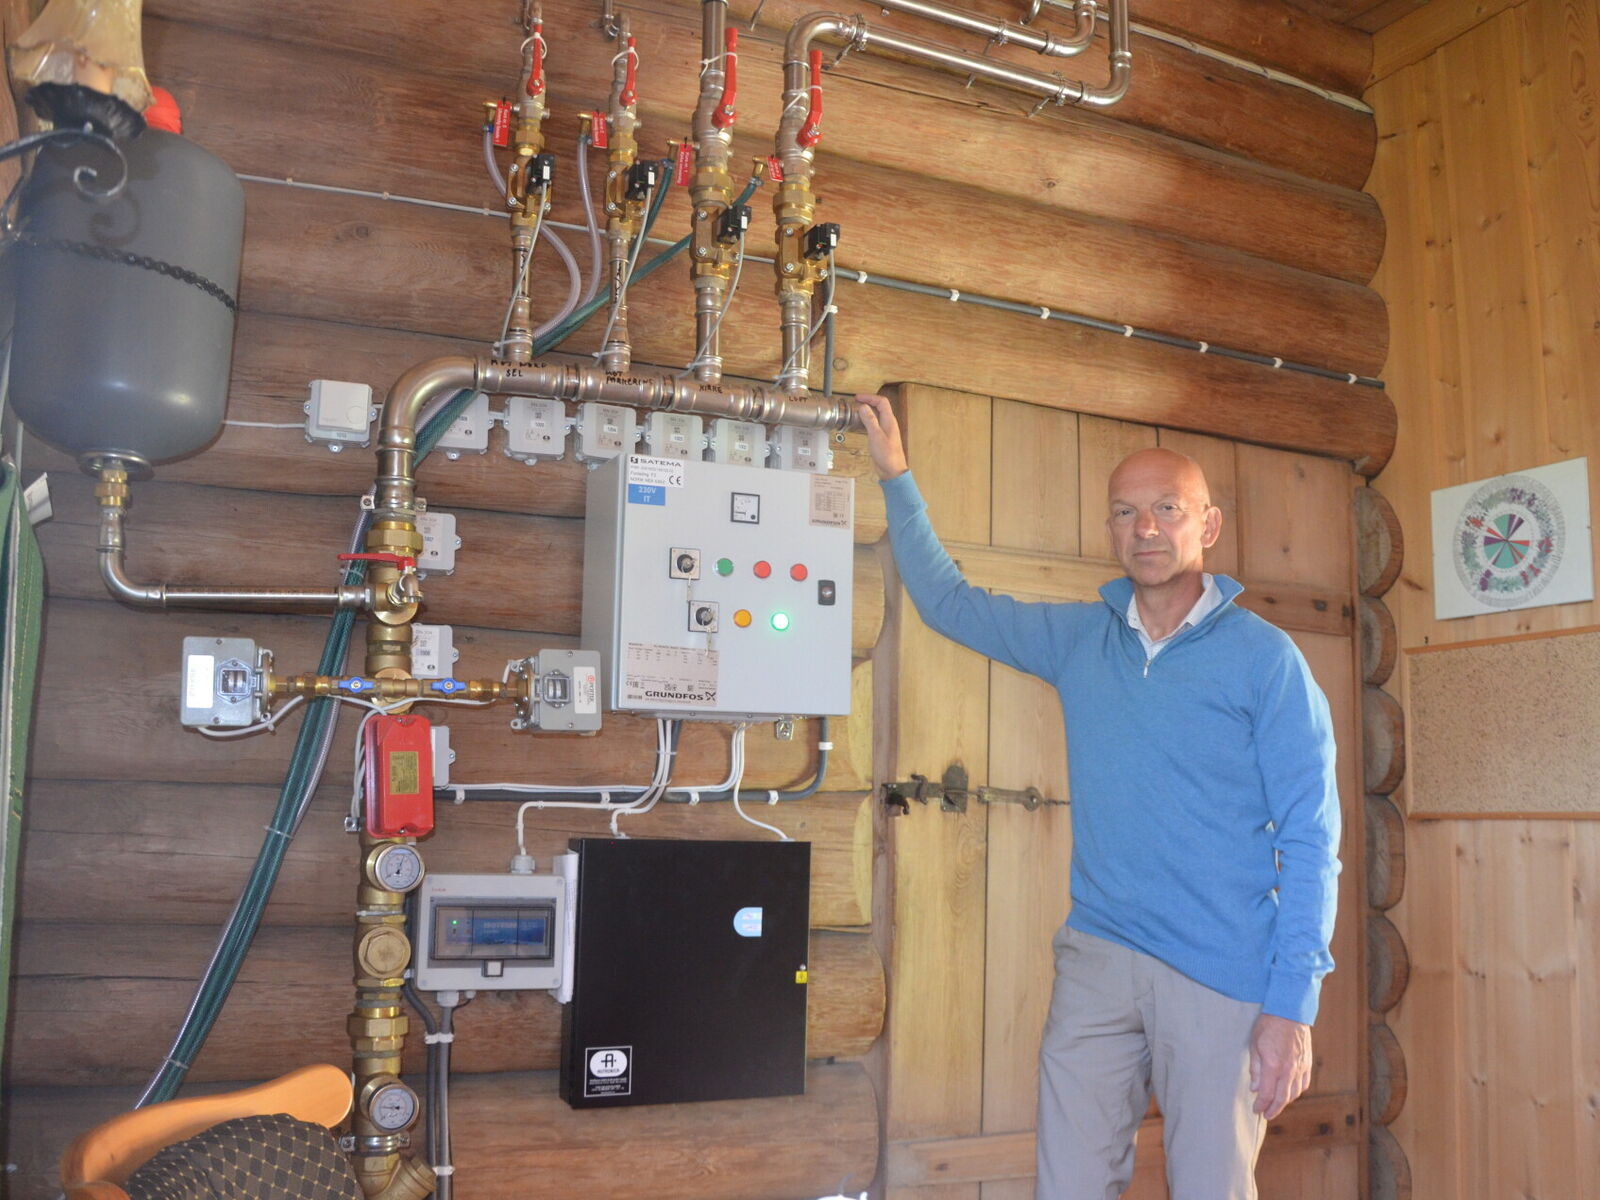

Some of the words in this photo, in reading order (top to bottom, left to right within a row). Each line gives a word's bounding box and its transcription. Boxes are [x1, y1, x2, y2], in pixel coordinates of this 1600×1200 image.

[640, 458, 682, 467] SATEMA
[638, 485, 657, 494] 230V
[643, 495, 651, 503] IT
[645, 690, 704, 701] GRUNDFOS
